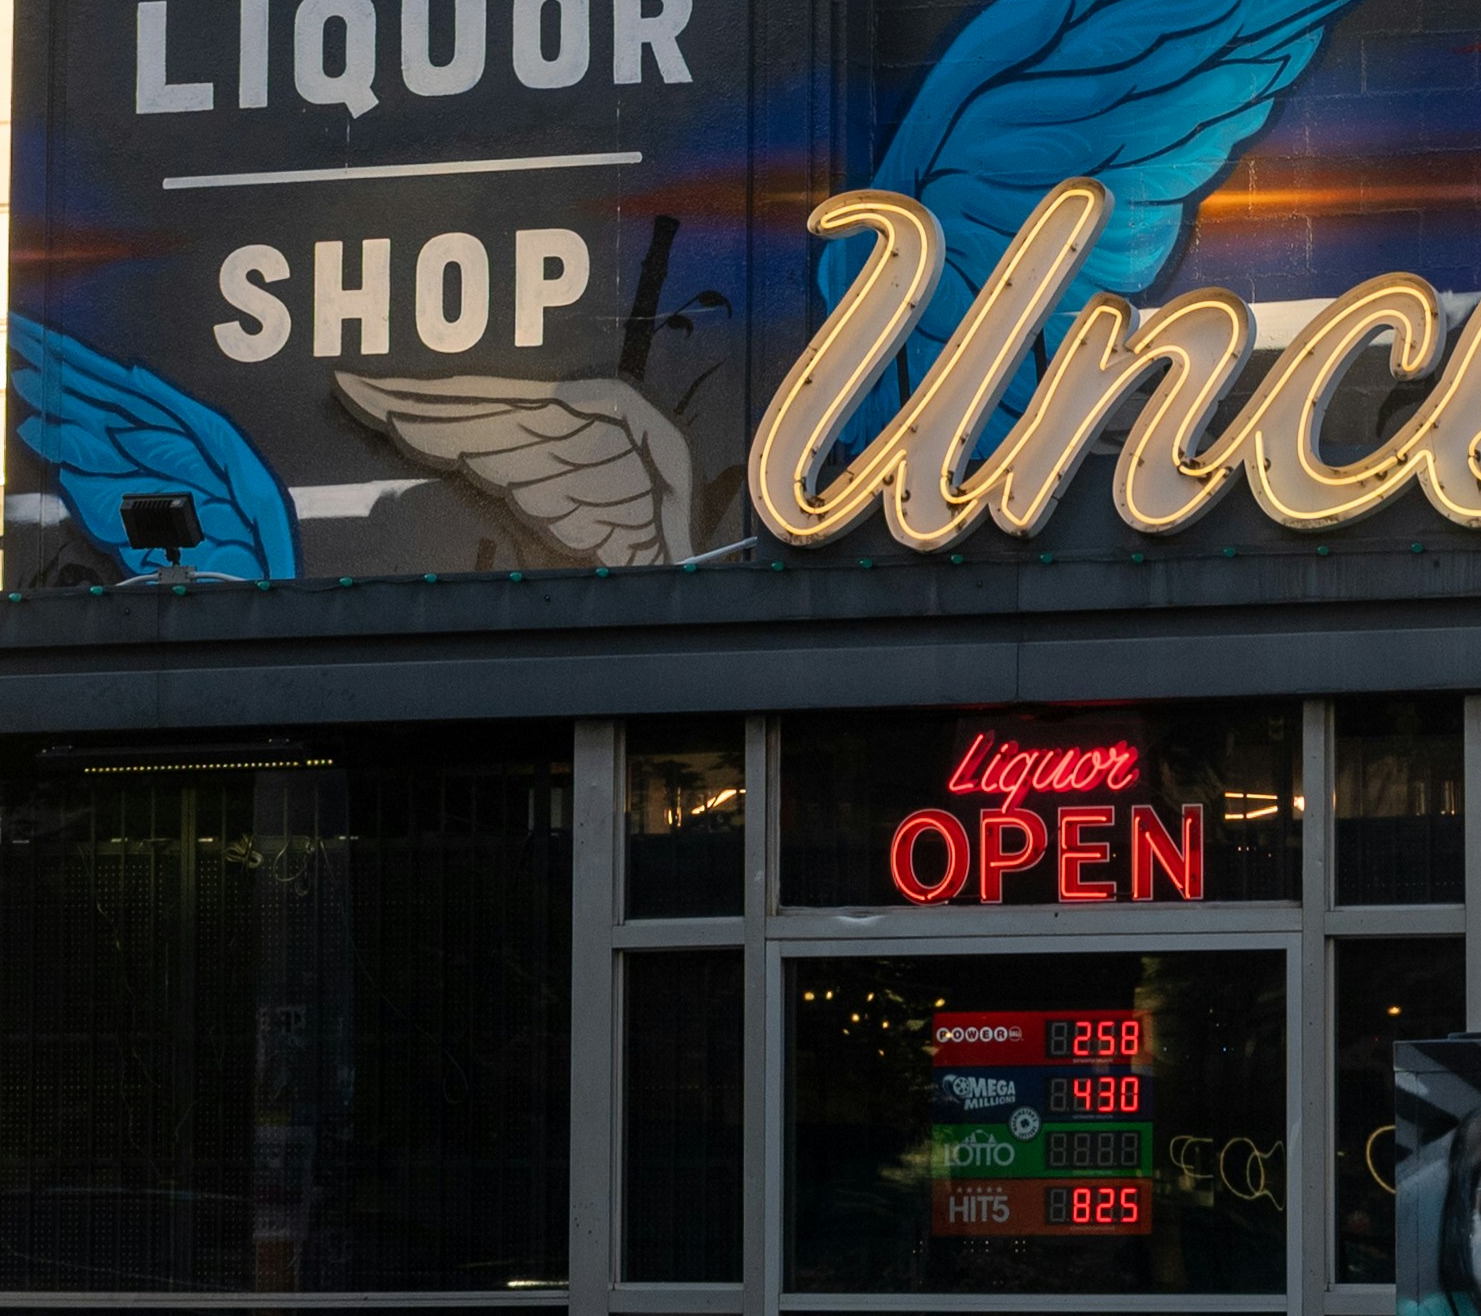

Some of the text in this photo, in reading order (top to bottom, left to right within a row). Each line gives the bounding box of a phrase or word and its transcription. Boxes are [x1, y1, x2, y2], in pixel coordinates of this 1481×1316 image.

[212, 227, 591, 364] SHOP
[948, 730, 1140, 814] Liquor
[891, 803, 1204, 907] OPEN
[1073, 1021, 1139, 1056] 258
[963, 1094, 1016, 1111] MILLIONS
[968, 1076, 1016, 1098] MEGA
[1073, 1076, 1139, 1112] 430
[944, 1141, 1016, 1167] LOTTO
[949, 1195, 1010, 1223] HIT5
[1072, 1187, 1138, 1224] 825
